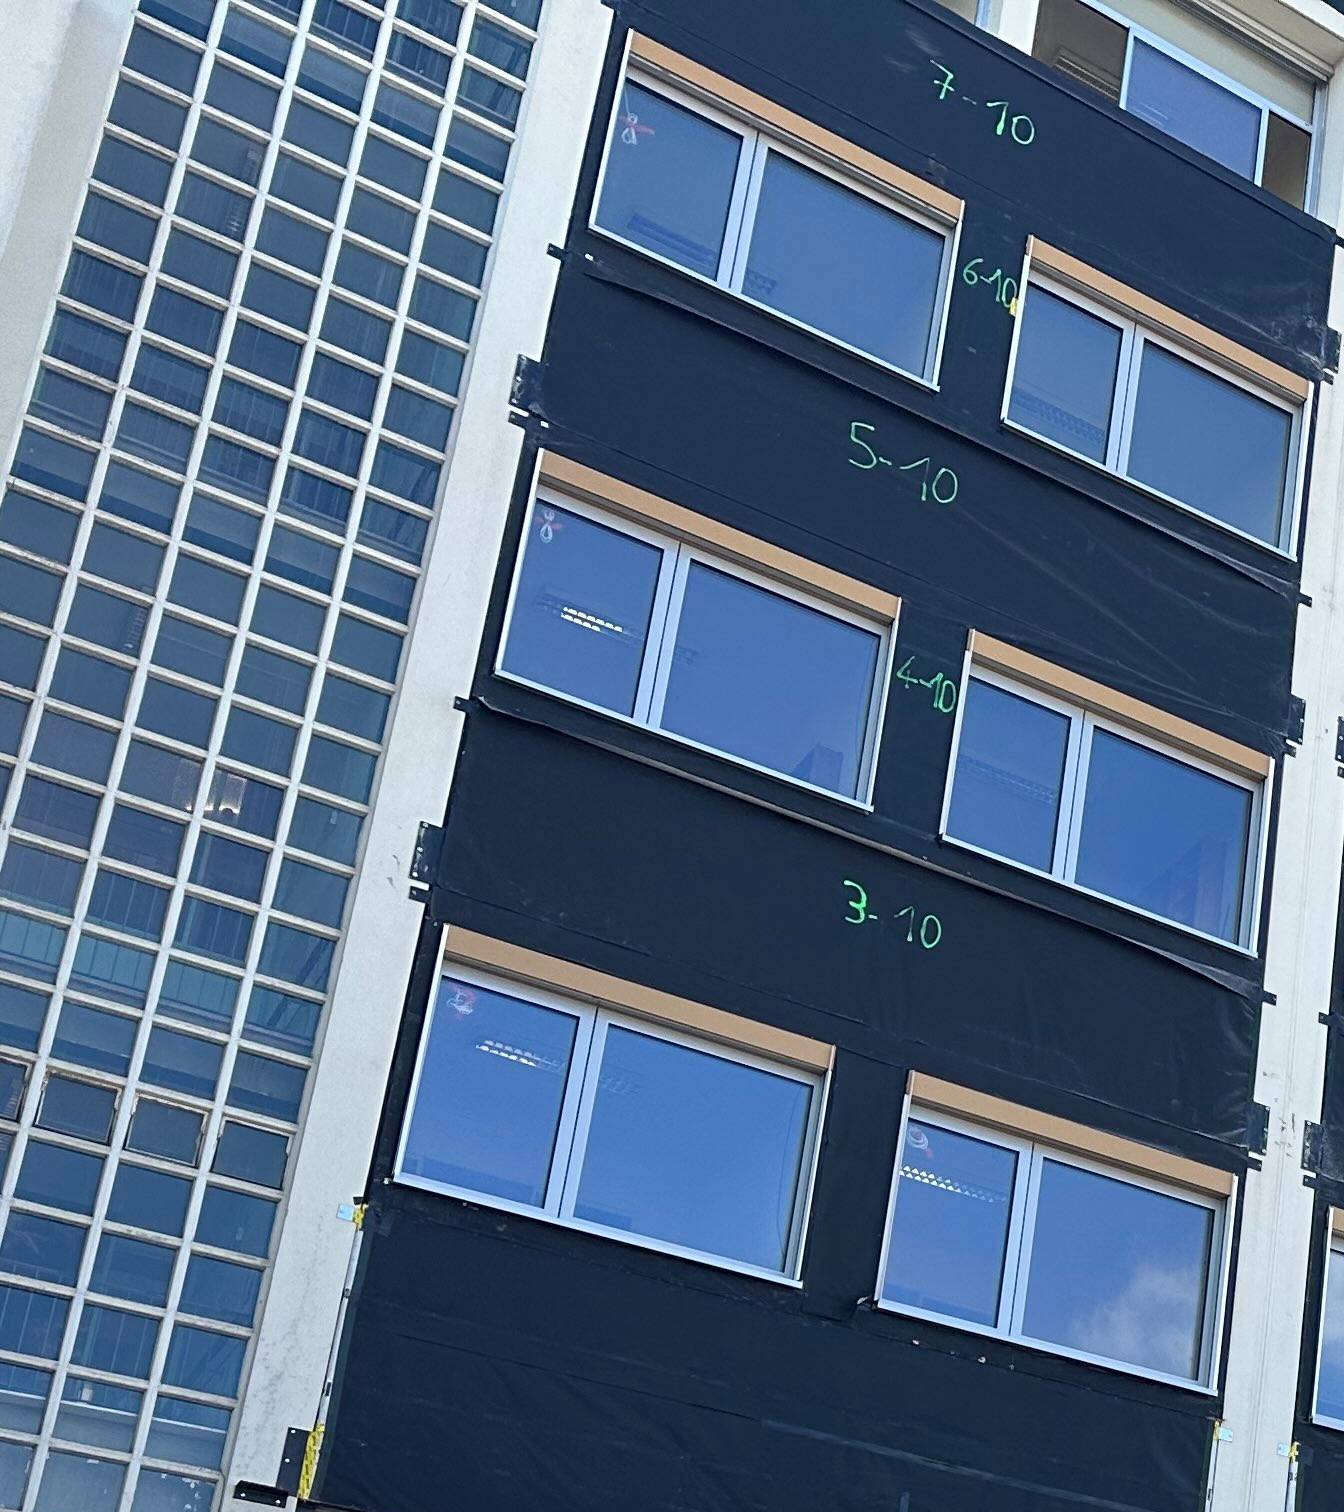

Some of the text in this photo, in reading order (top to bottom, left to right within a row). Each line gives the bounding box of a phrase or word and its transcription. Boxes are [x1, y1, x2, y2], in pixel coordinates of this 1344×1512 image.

[929, 58, 1036, 146] 7-10
[962, 257, 1019, 312] 6-10
[848, 422, 959, 505] 5-10
[896, 656, 957, 714] 4-10
[842, 880, 943, 950] 3-10
